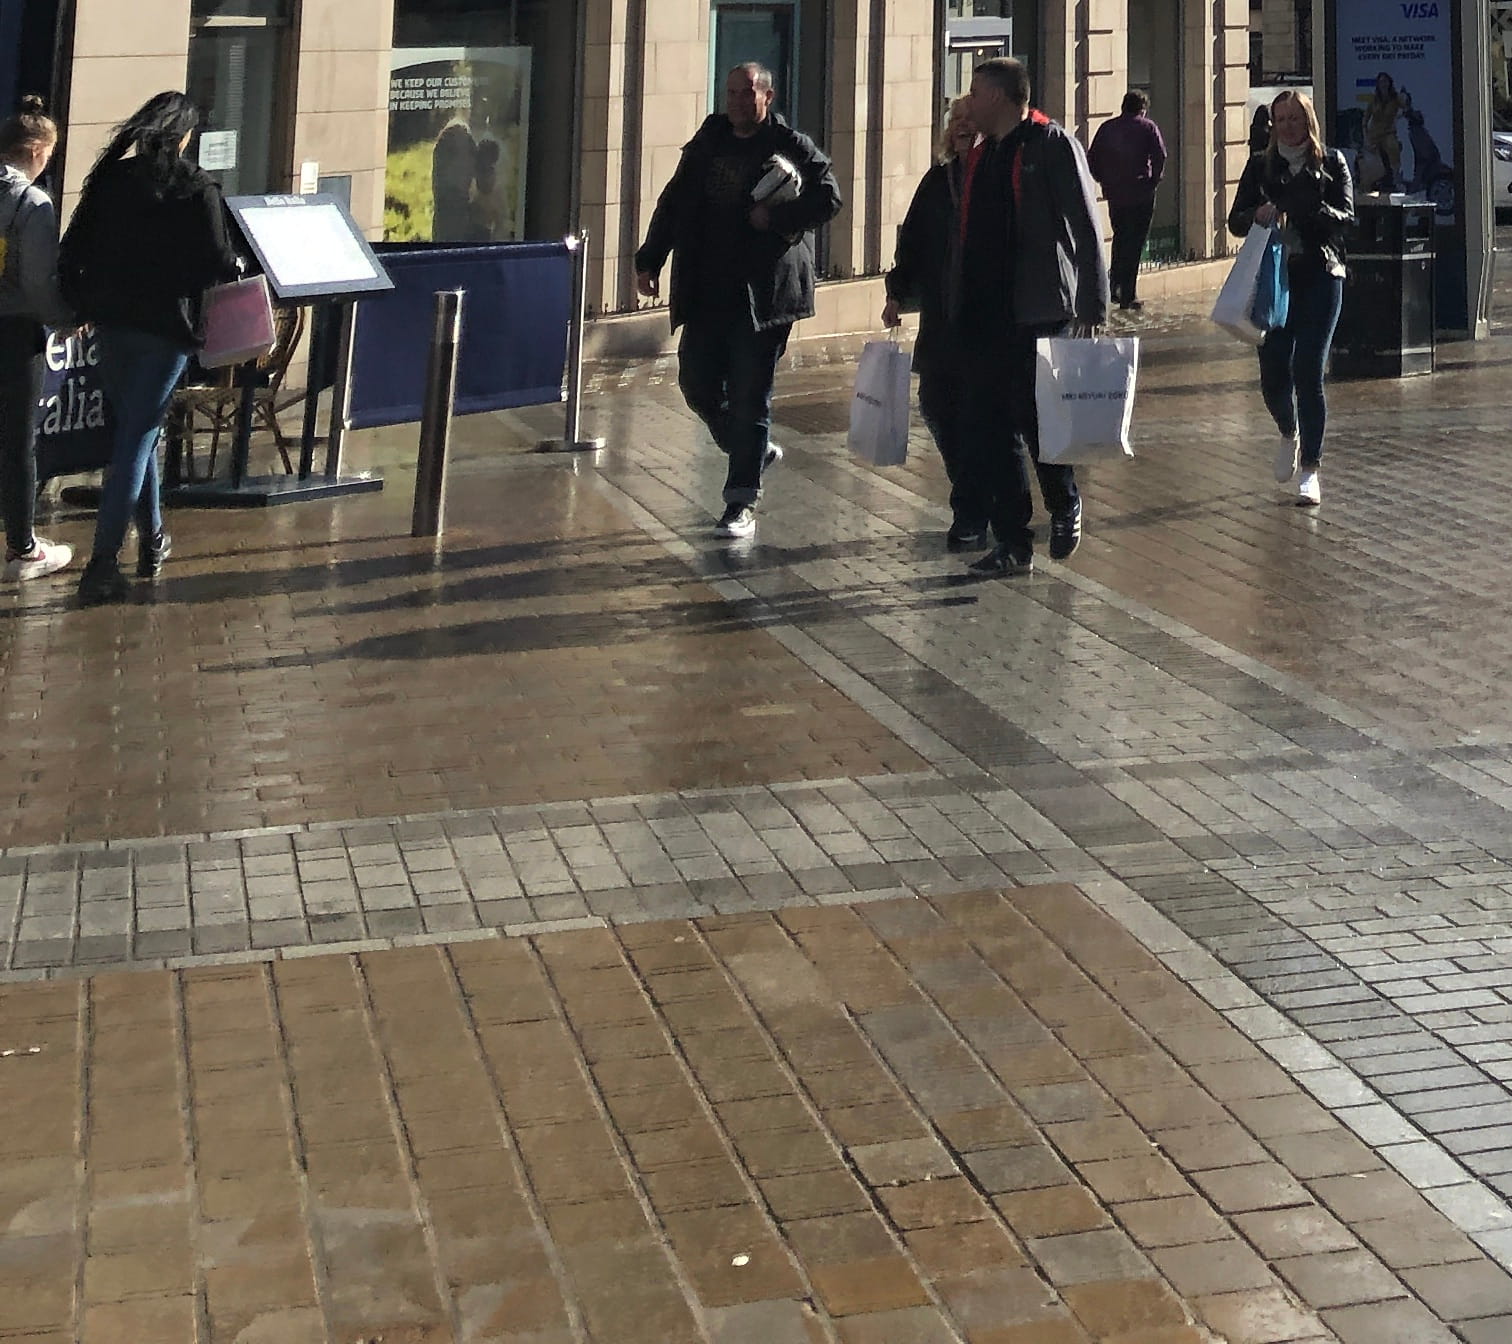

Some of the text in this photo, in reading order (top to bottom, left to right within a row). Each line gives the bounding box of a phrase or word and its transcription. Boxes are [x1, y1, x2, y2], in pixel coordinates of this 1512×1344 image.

[1400, 2, 1439, 19] VISA
[391, 79, 402, 88] WE
[405, 78, 424, 88] KEEP
[426, 77, 442, 87] OUR
[390, 90, 424, 99] BECAUSE
[427, 89, 438, 98] WE
[390, 101, 398, 110] IN
[400, 100, 432, 110] KEEPING
[39, 375, 105, 434] alia
